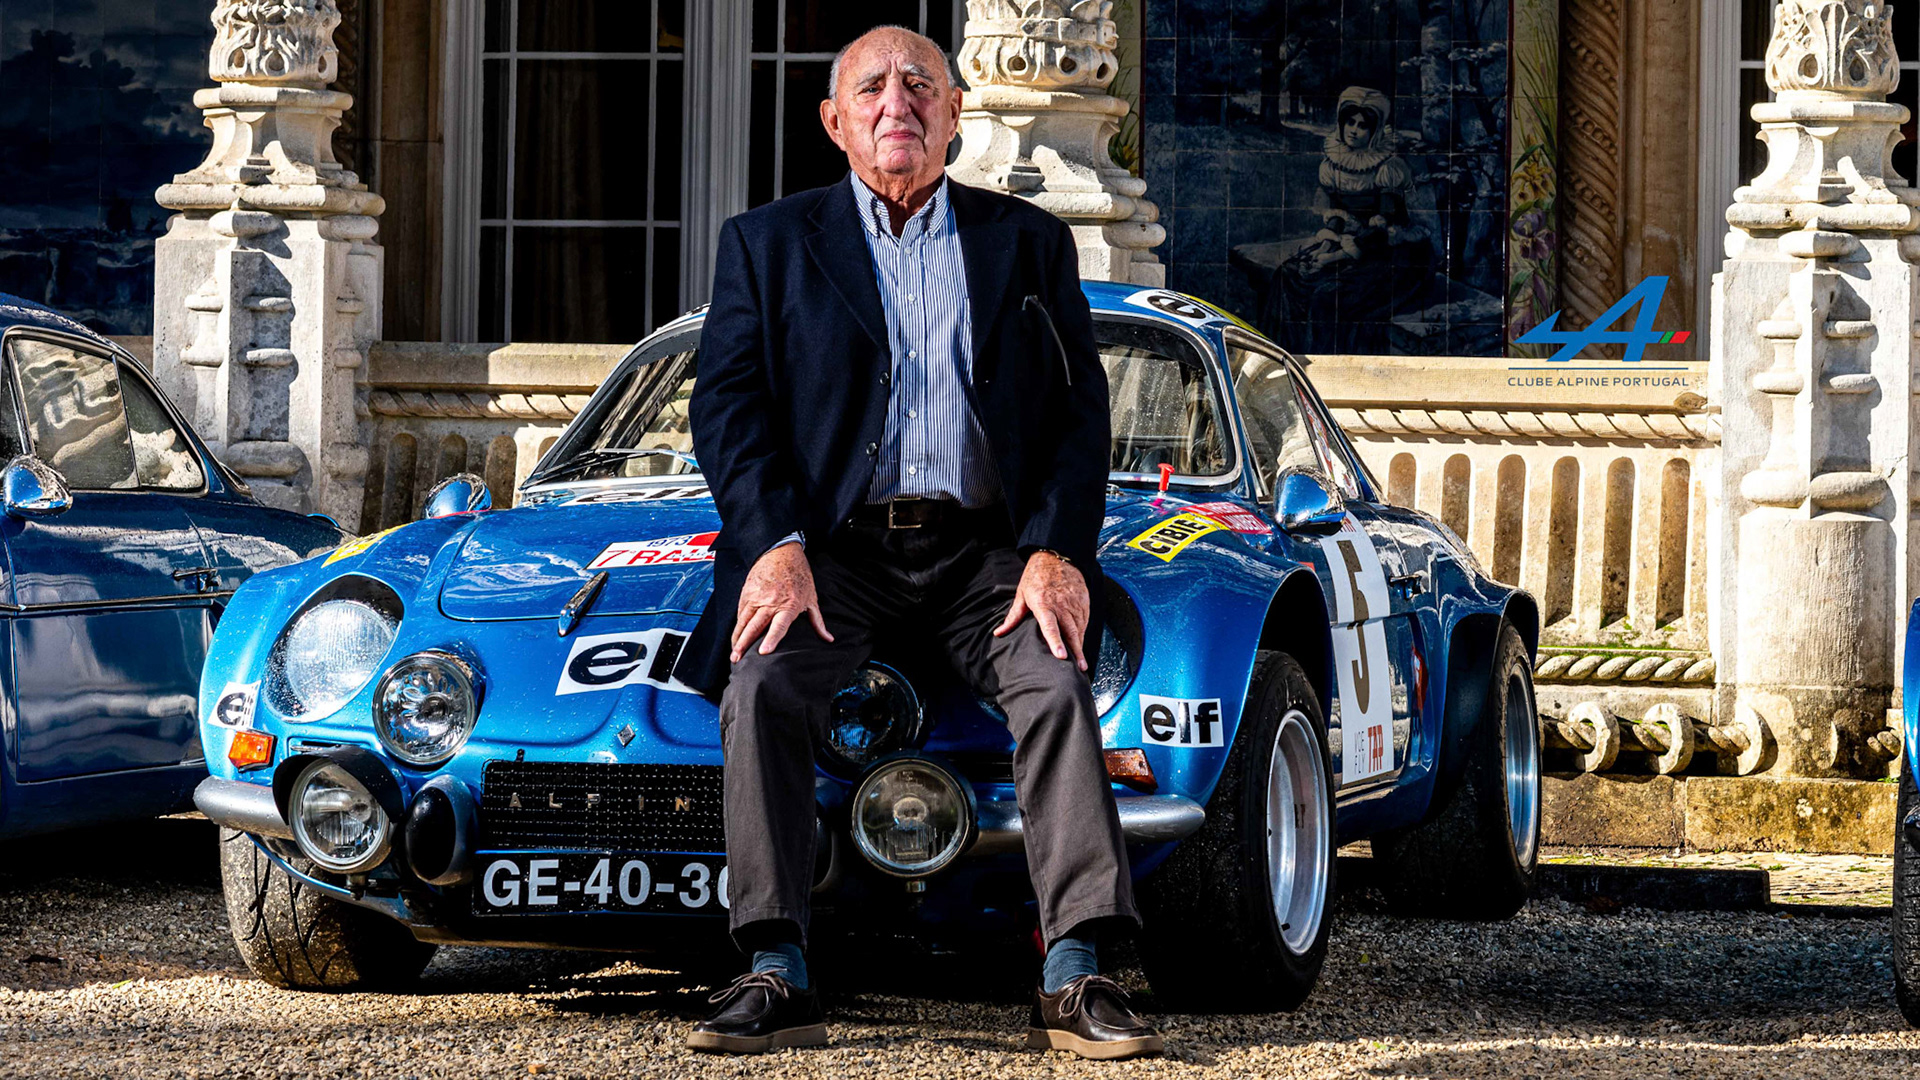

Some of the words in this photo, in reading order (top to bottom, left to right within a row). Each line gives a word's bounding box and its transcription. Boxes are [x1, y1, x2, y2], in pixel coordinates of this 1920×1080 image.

[646, 535, 693, 547] 1973
[1336, 540, 1370, 714] 5
[568, 632, 687, 686] el
[1143, 701, 1220, 744] elf
[1367, 724, 1384, 773] TAP
[508, 792, 691, 812] ALPIN
